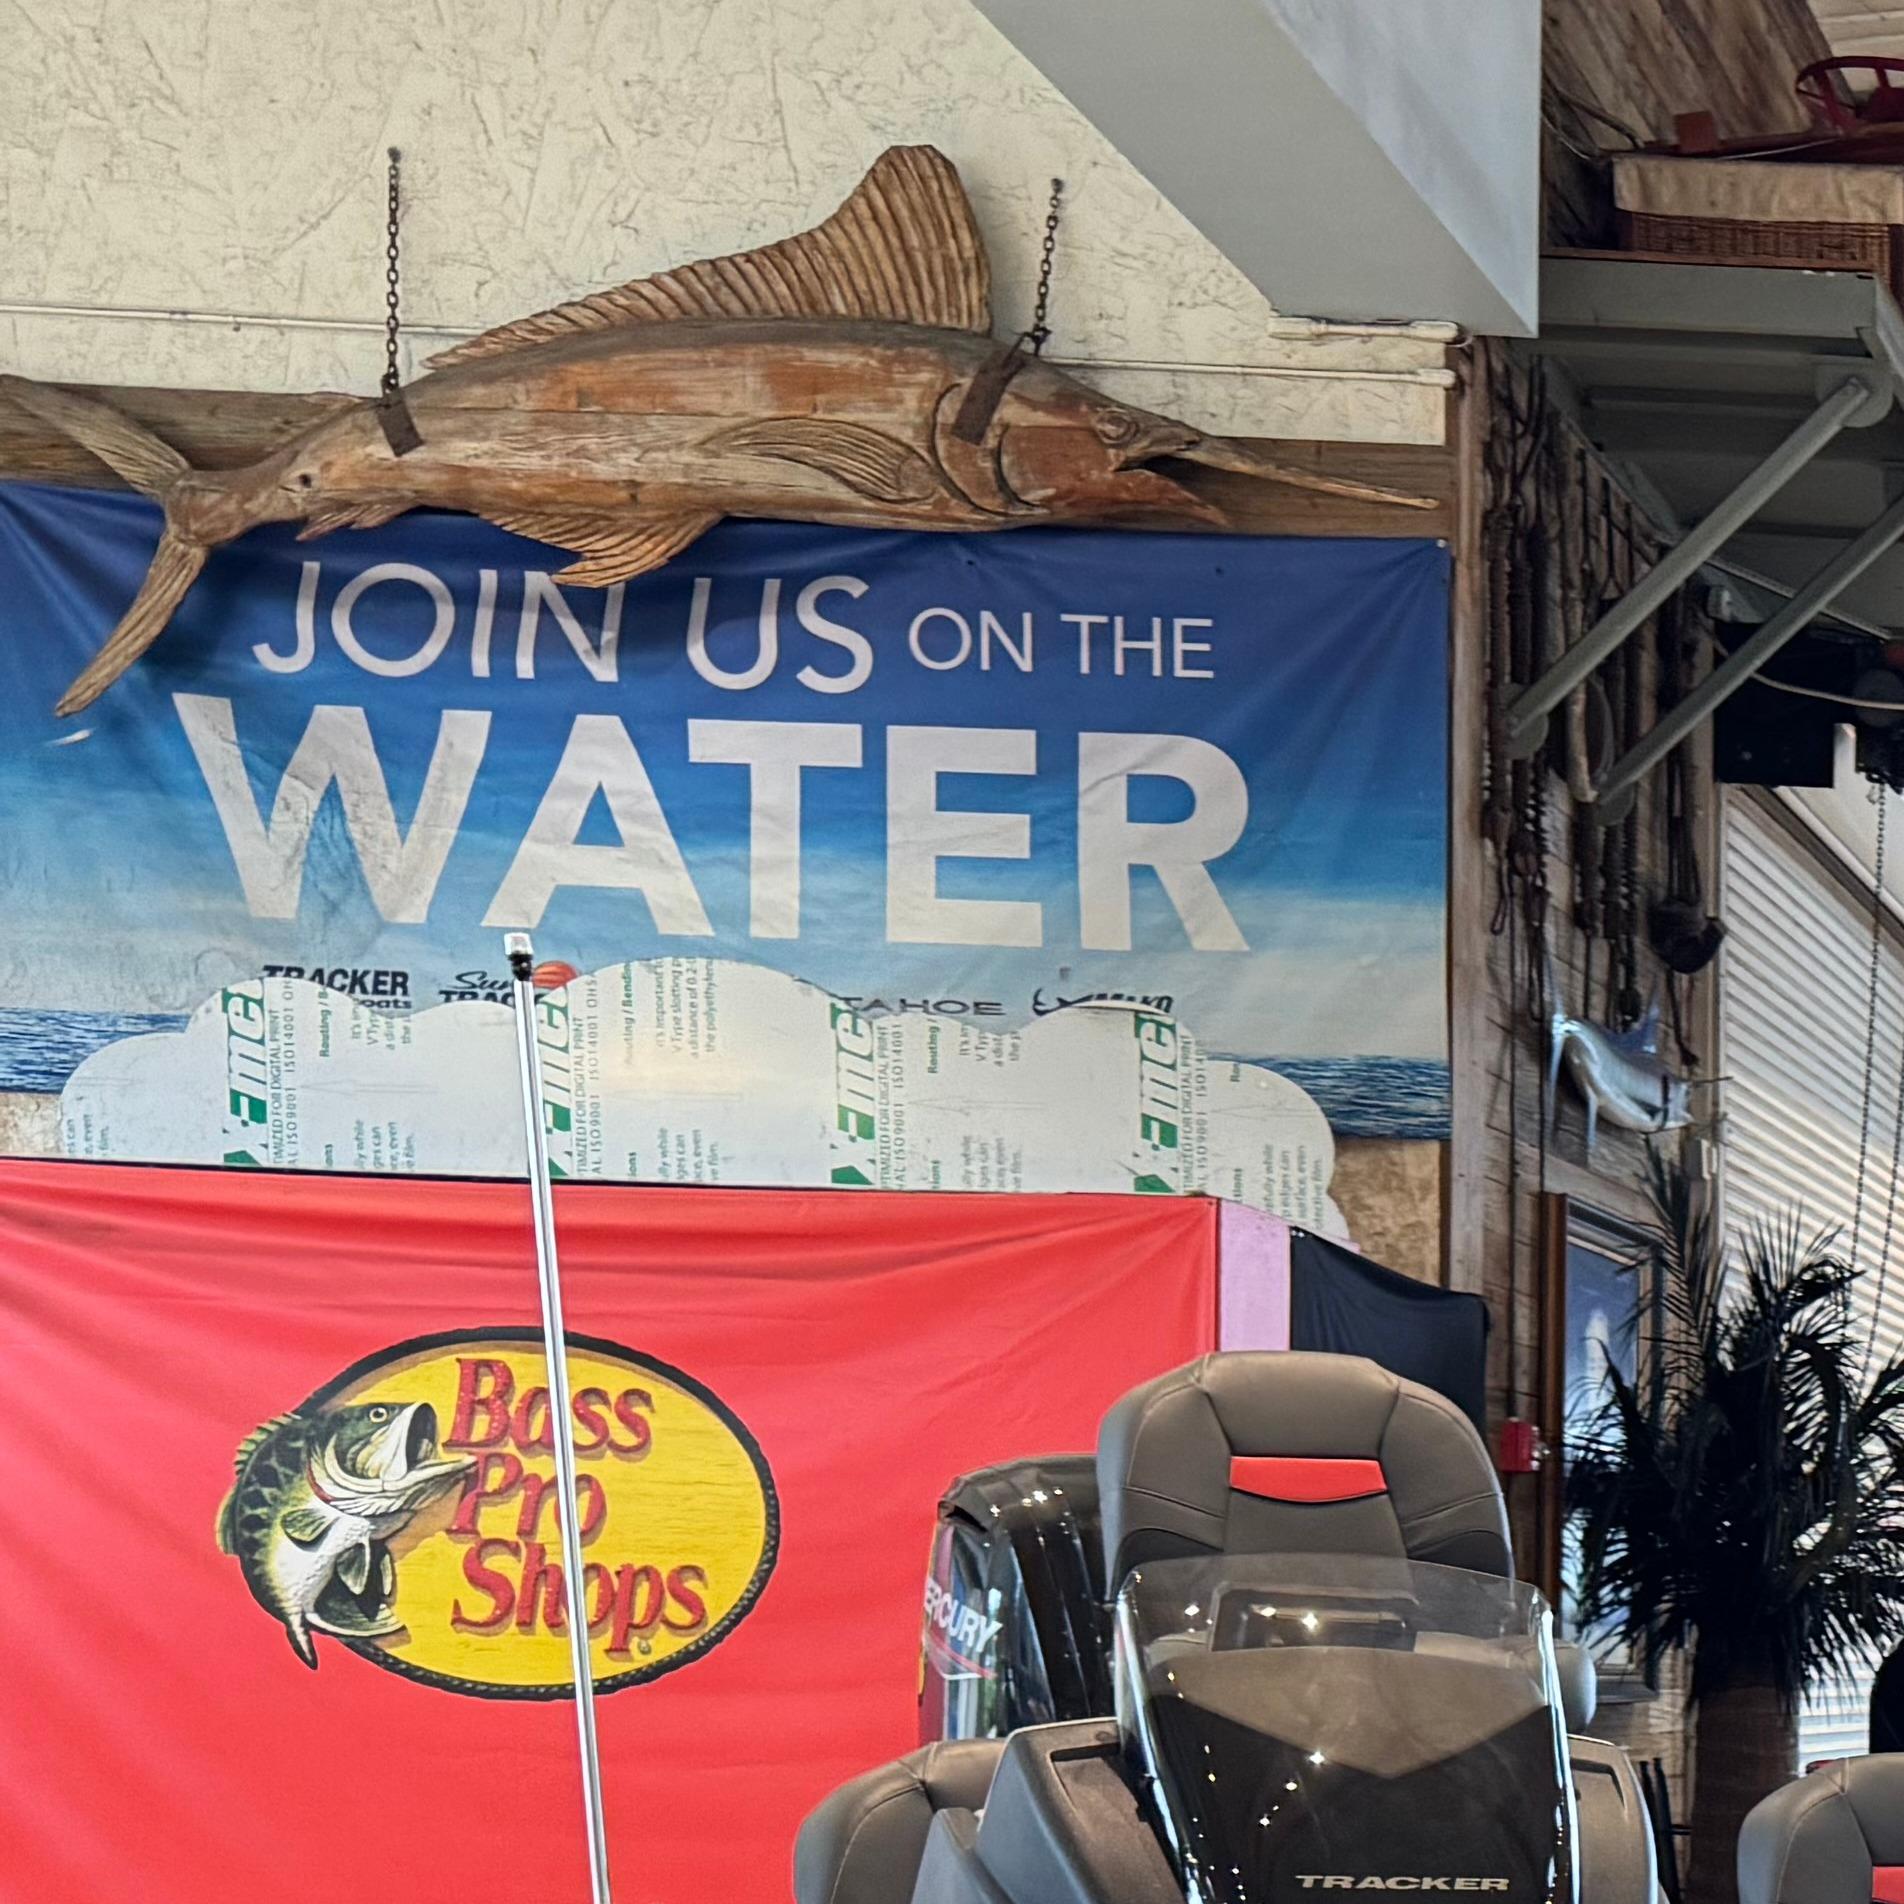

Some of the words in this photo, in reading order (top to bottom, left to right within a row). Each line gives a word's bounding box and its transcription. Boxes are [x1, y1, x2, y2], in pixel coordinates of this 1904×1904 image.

[252, 561, 621, 682] JOIN
[685, 575, 876, 693] US
[908, 606, 1034, 677] ON
[1060, 612, 1216, 680] THE
[172, 692, 1252, 952] WATER
[621, 962, 633, 1007] Bendin
[442, 1357, 654, 1455] Bass
[451, 1536, 709, 1658] Shops
[1294, 1873, 1510, 1891] TRACKER
